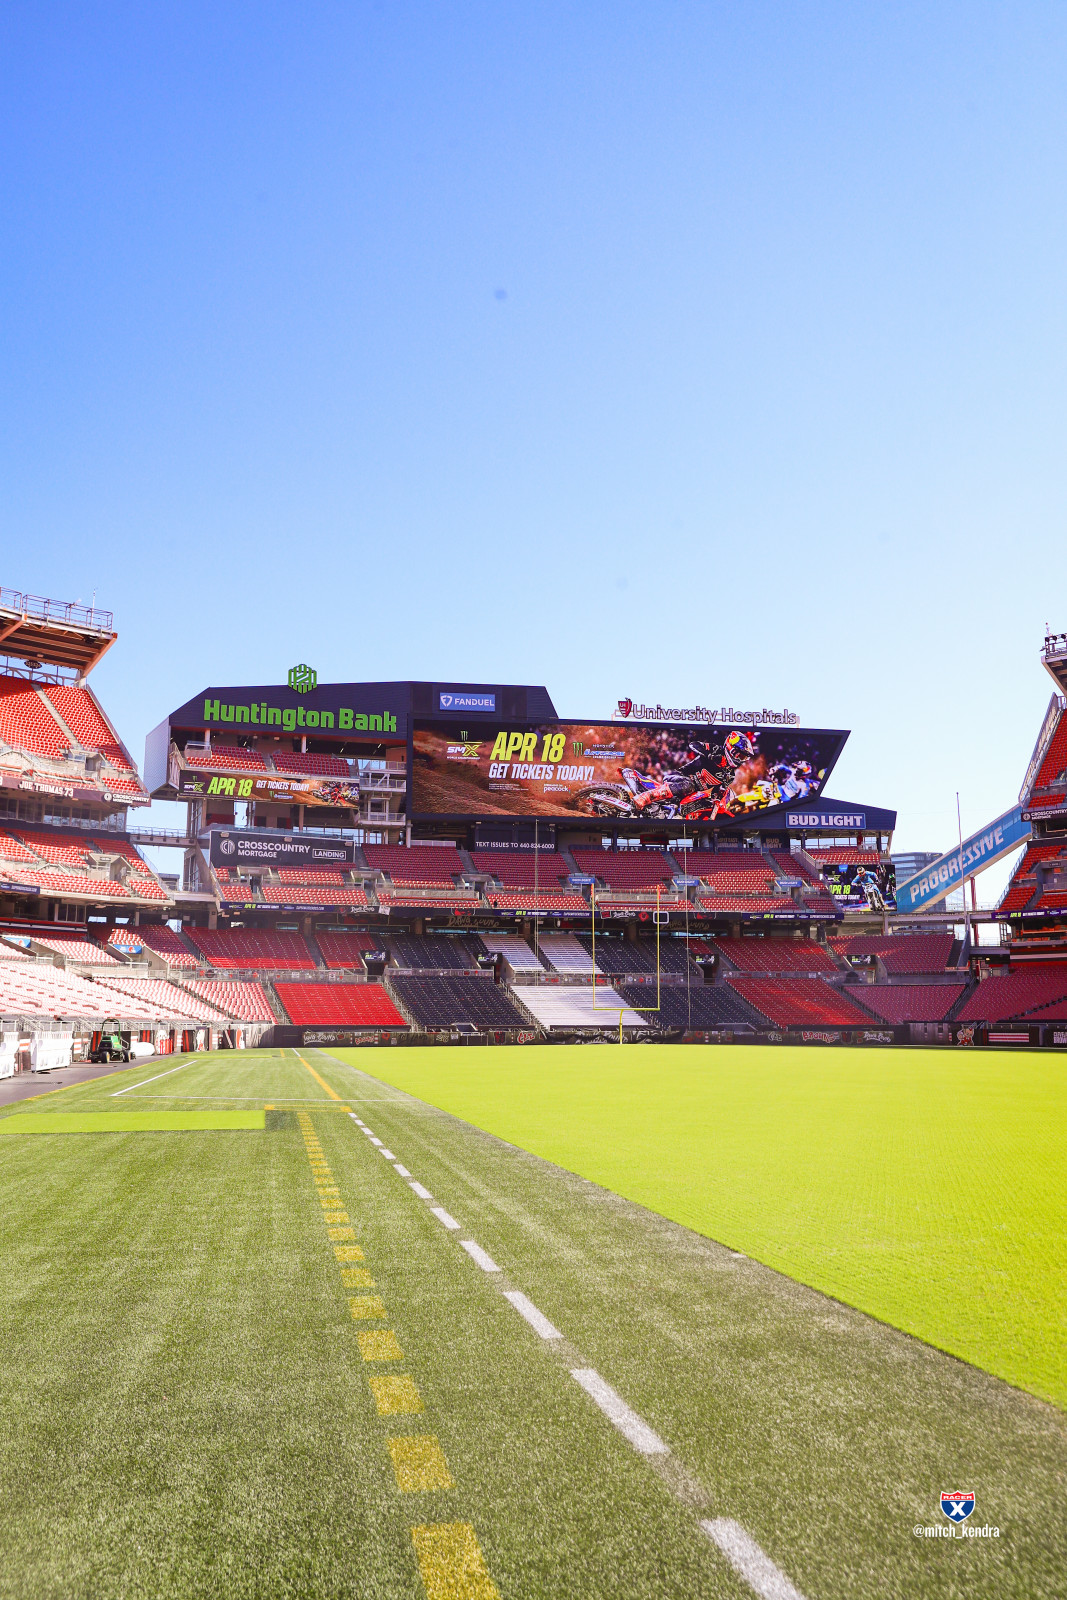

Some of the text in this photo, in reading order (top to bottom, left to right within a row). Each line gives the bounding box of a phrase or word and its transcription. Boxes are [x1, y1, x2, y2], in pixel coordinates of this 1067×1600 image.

[454, 698, 495, 707] FANDUEL
[203, 699, 397, 732] Huntington Bank
[632, 704, 796, 728] University Hospitals
[490, 732, 566, 763] APR 18
[489, 763, 595, 781] GET TICKETS TODAY!
[20, 781, 73, 797] JOE THOMAS 73
[207, 776, 253, 797] APR 18
[256, 780, 309, 791] GET TICKETS TODAY!
[543, 785, 568, 793] peacock
[788, 815, 863, 826] BUD LIGHT
[238, 840, 310, 853] CROSSCOUNTRY
[238, 850, 277, 858] MORTGAGE
[314, 850, 345, 858] LANDING
[910, 826, 1004, 903] PROGRESSIVE
[842, 884, 851, 895] 18
